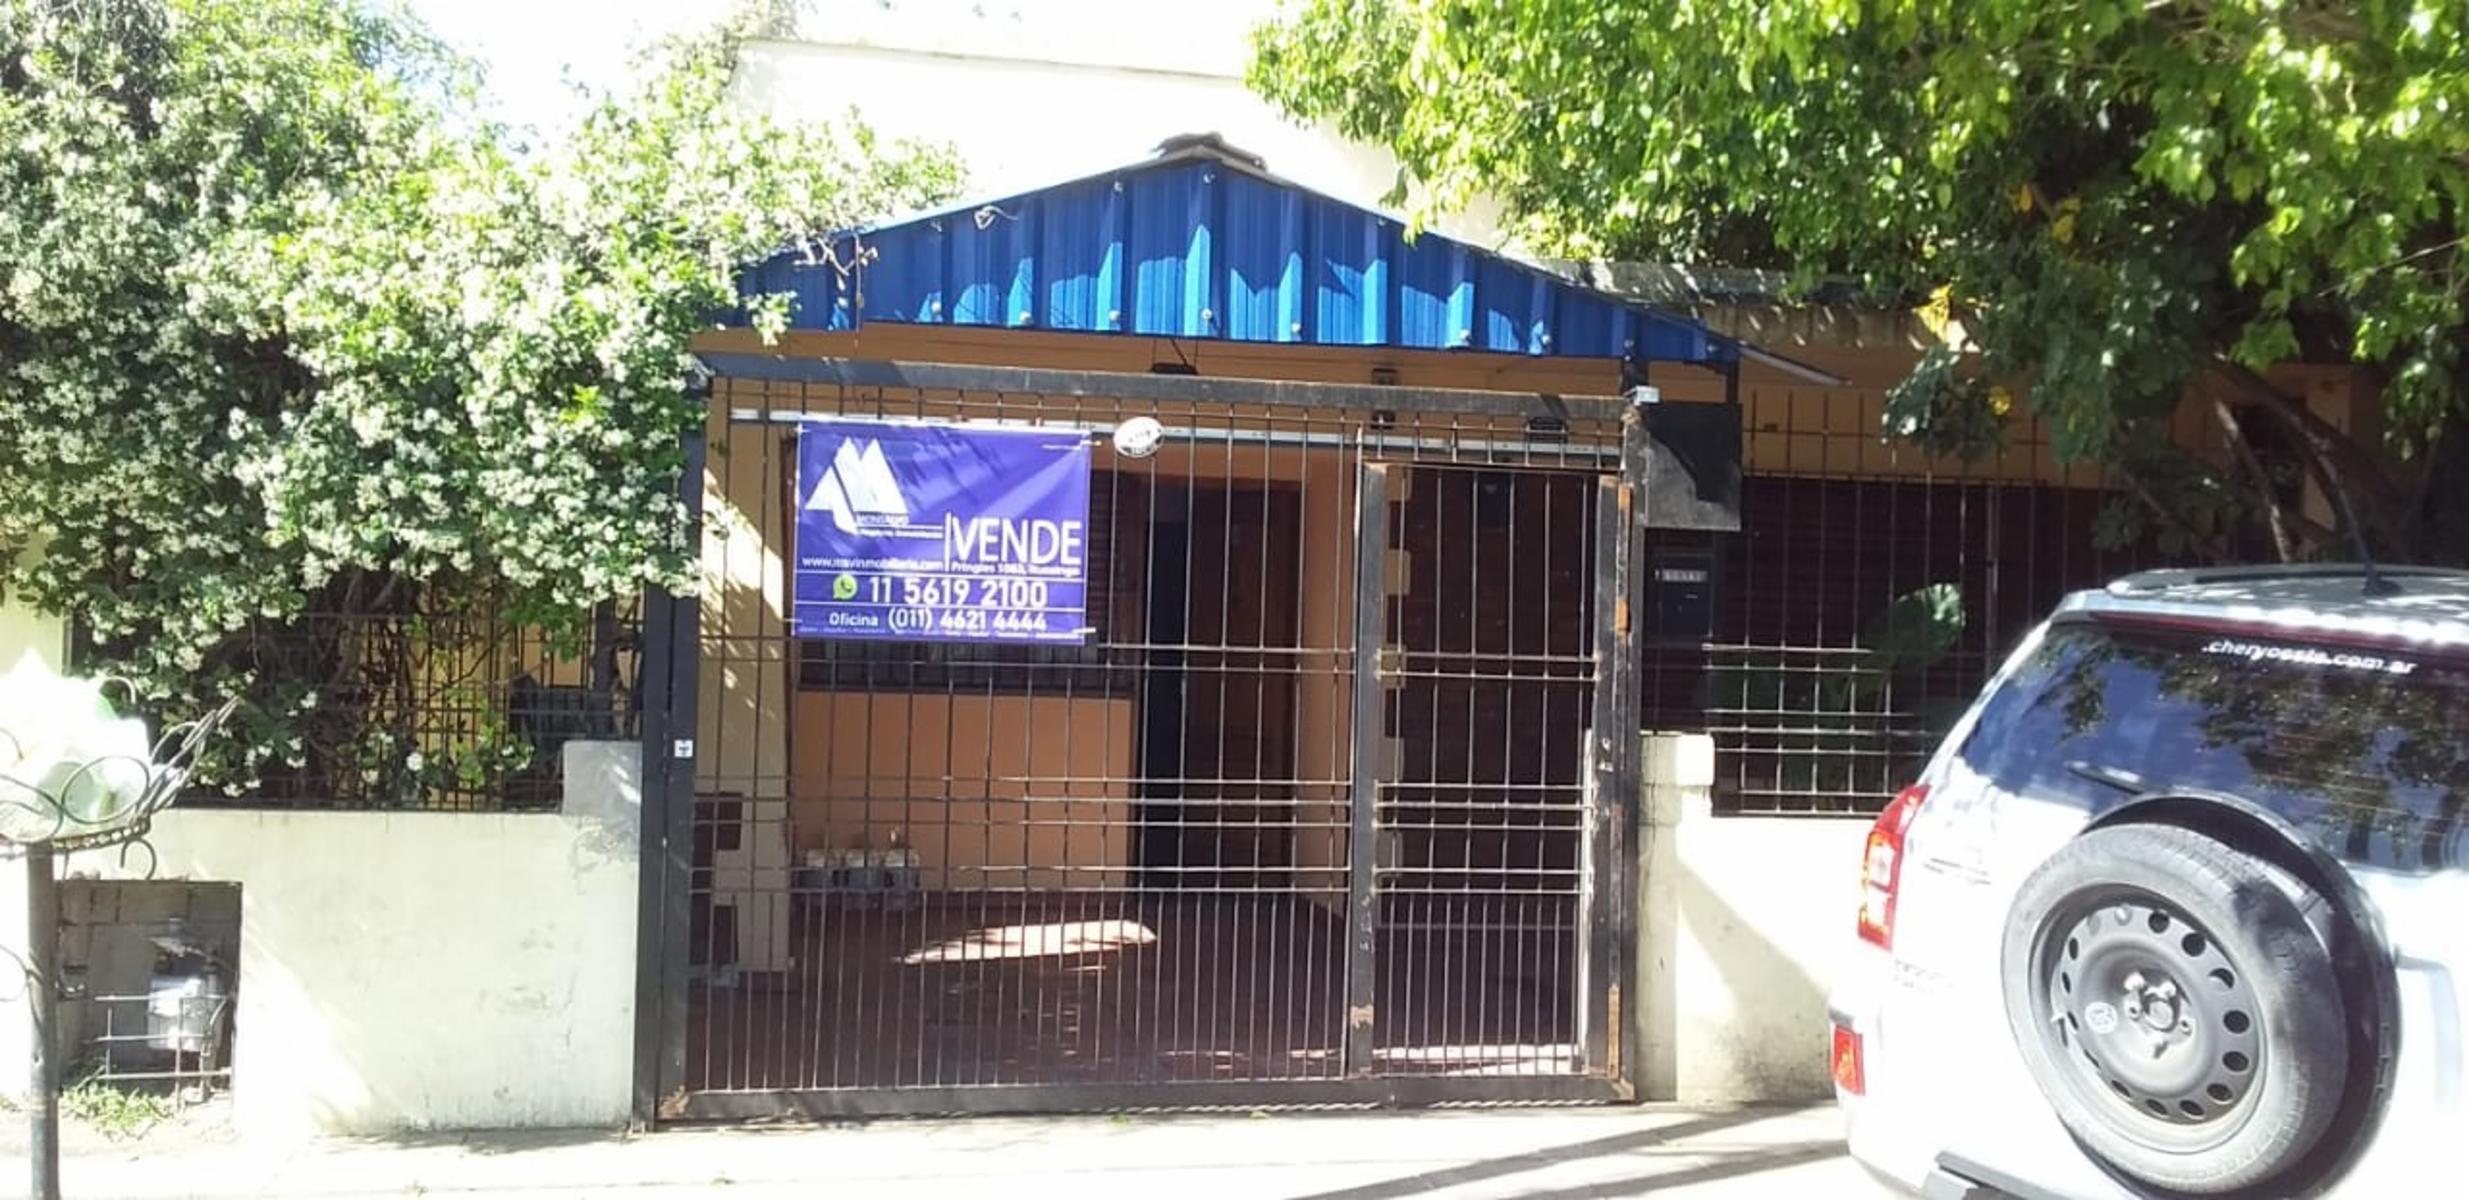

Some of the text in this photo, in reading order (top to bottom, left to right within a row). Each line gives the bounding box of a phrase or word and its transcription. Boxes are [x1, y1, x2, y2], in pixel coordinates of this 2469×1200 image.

[952, 516, 1082, 566] VENDE
[869, 576, 1048, 608] 11 5619 2100
[828, 606, 1047, 631] Oficina (011) 4621 4444
